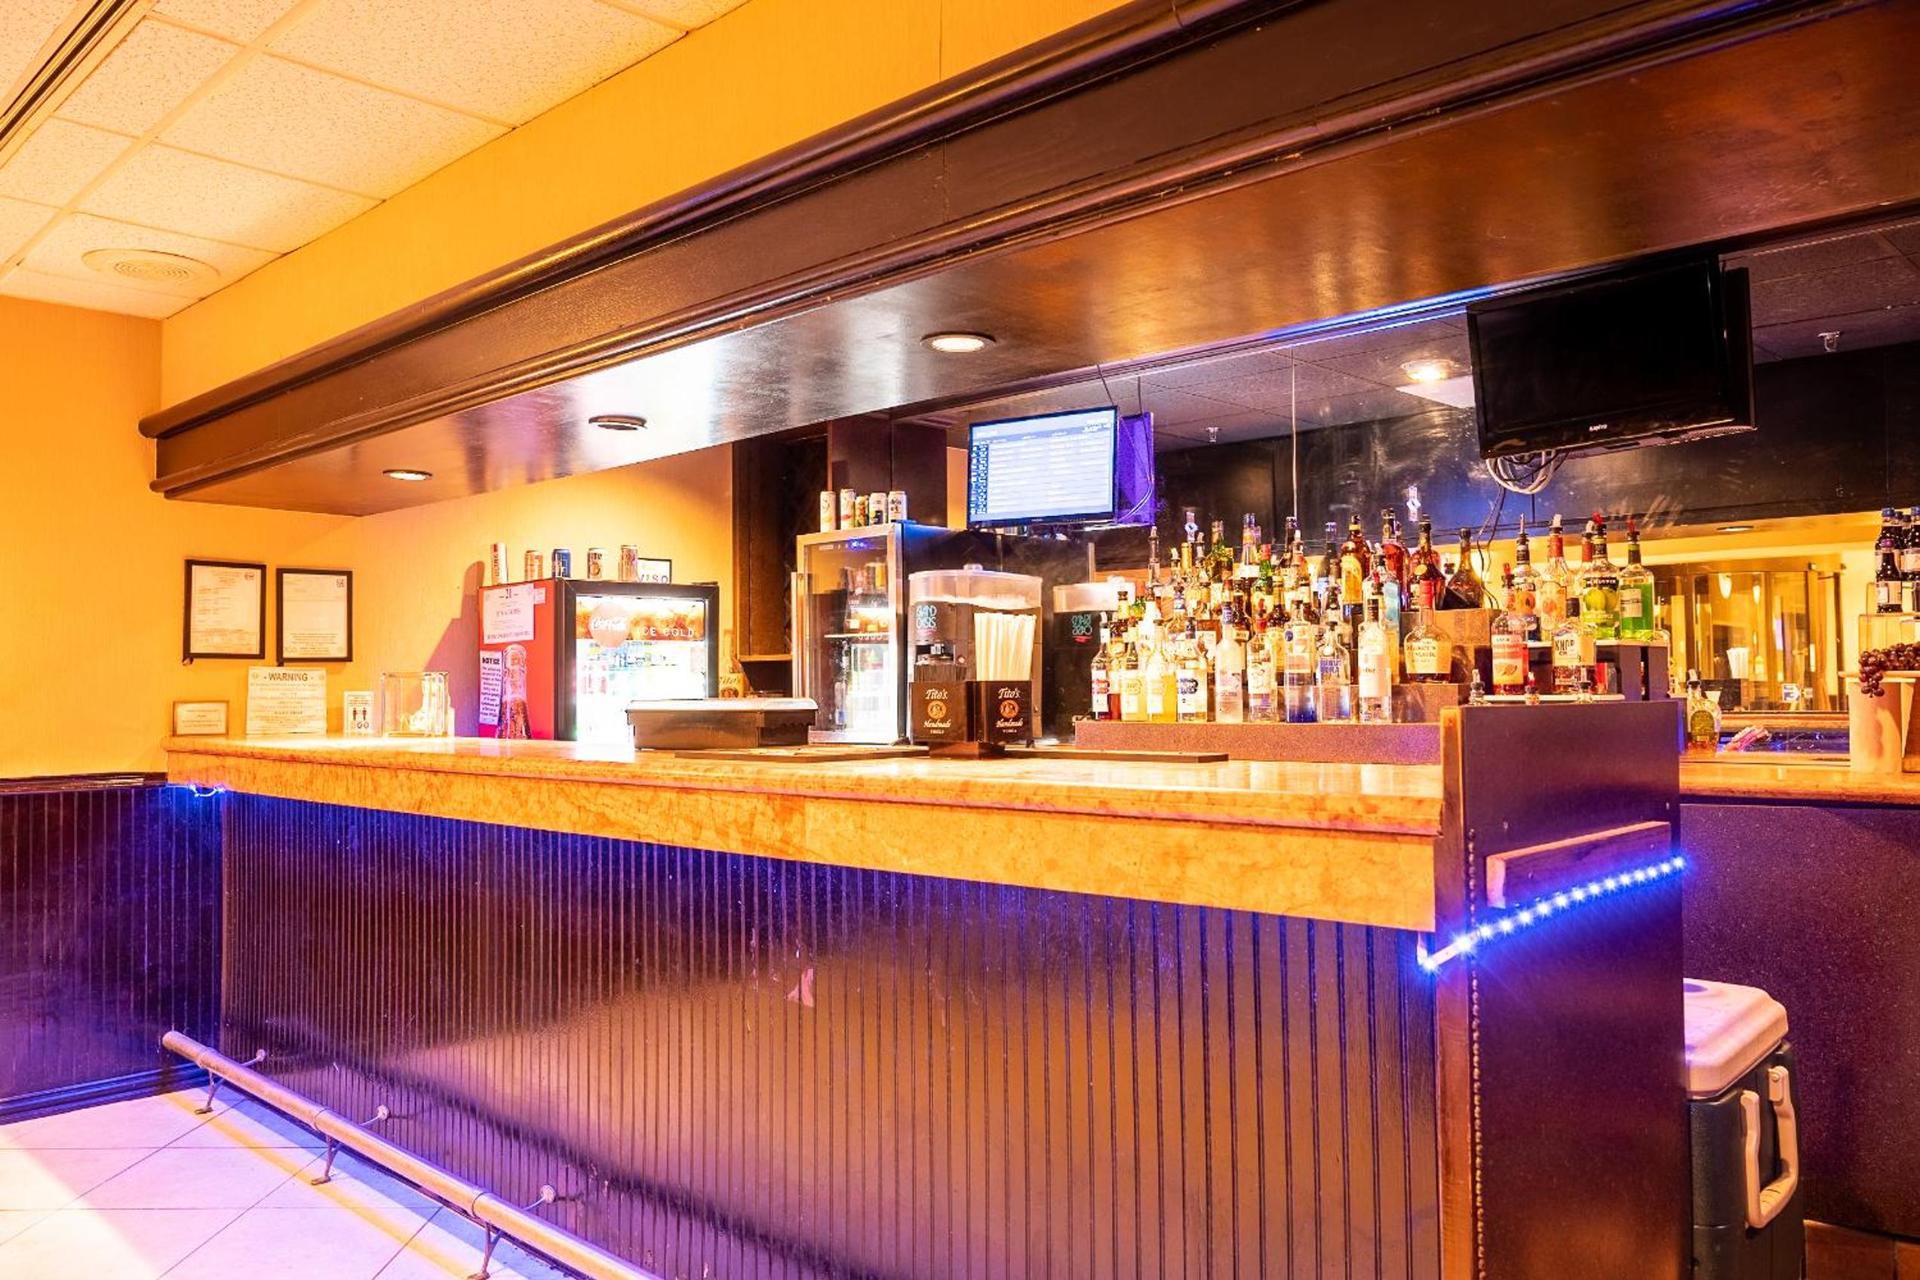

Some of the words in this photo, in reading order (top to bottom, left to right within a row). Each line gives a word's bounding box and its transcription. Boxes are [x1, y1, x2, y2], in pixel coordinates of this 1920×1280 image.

[482, 657, 500, 665] NOTICE
[268, 672, 308, 682] WARNING
[925, 688, 948, 699] Tito's
[998, 687, 1020, 699] Tito's
